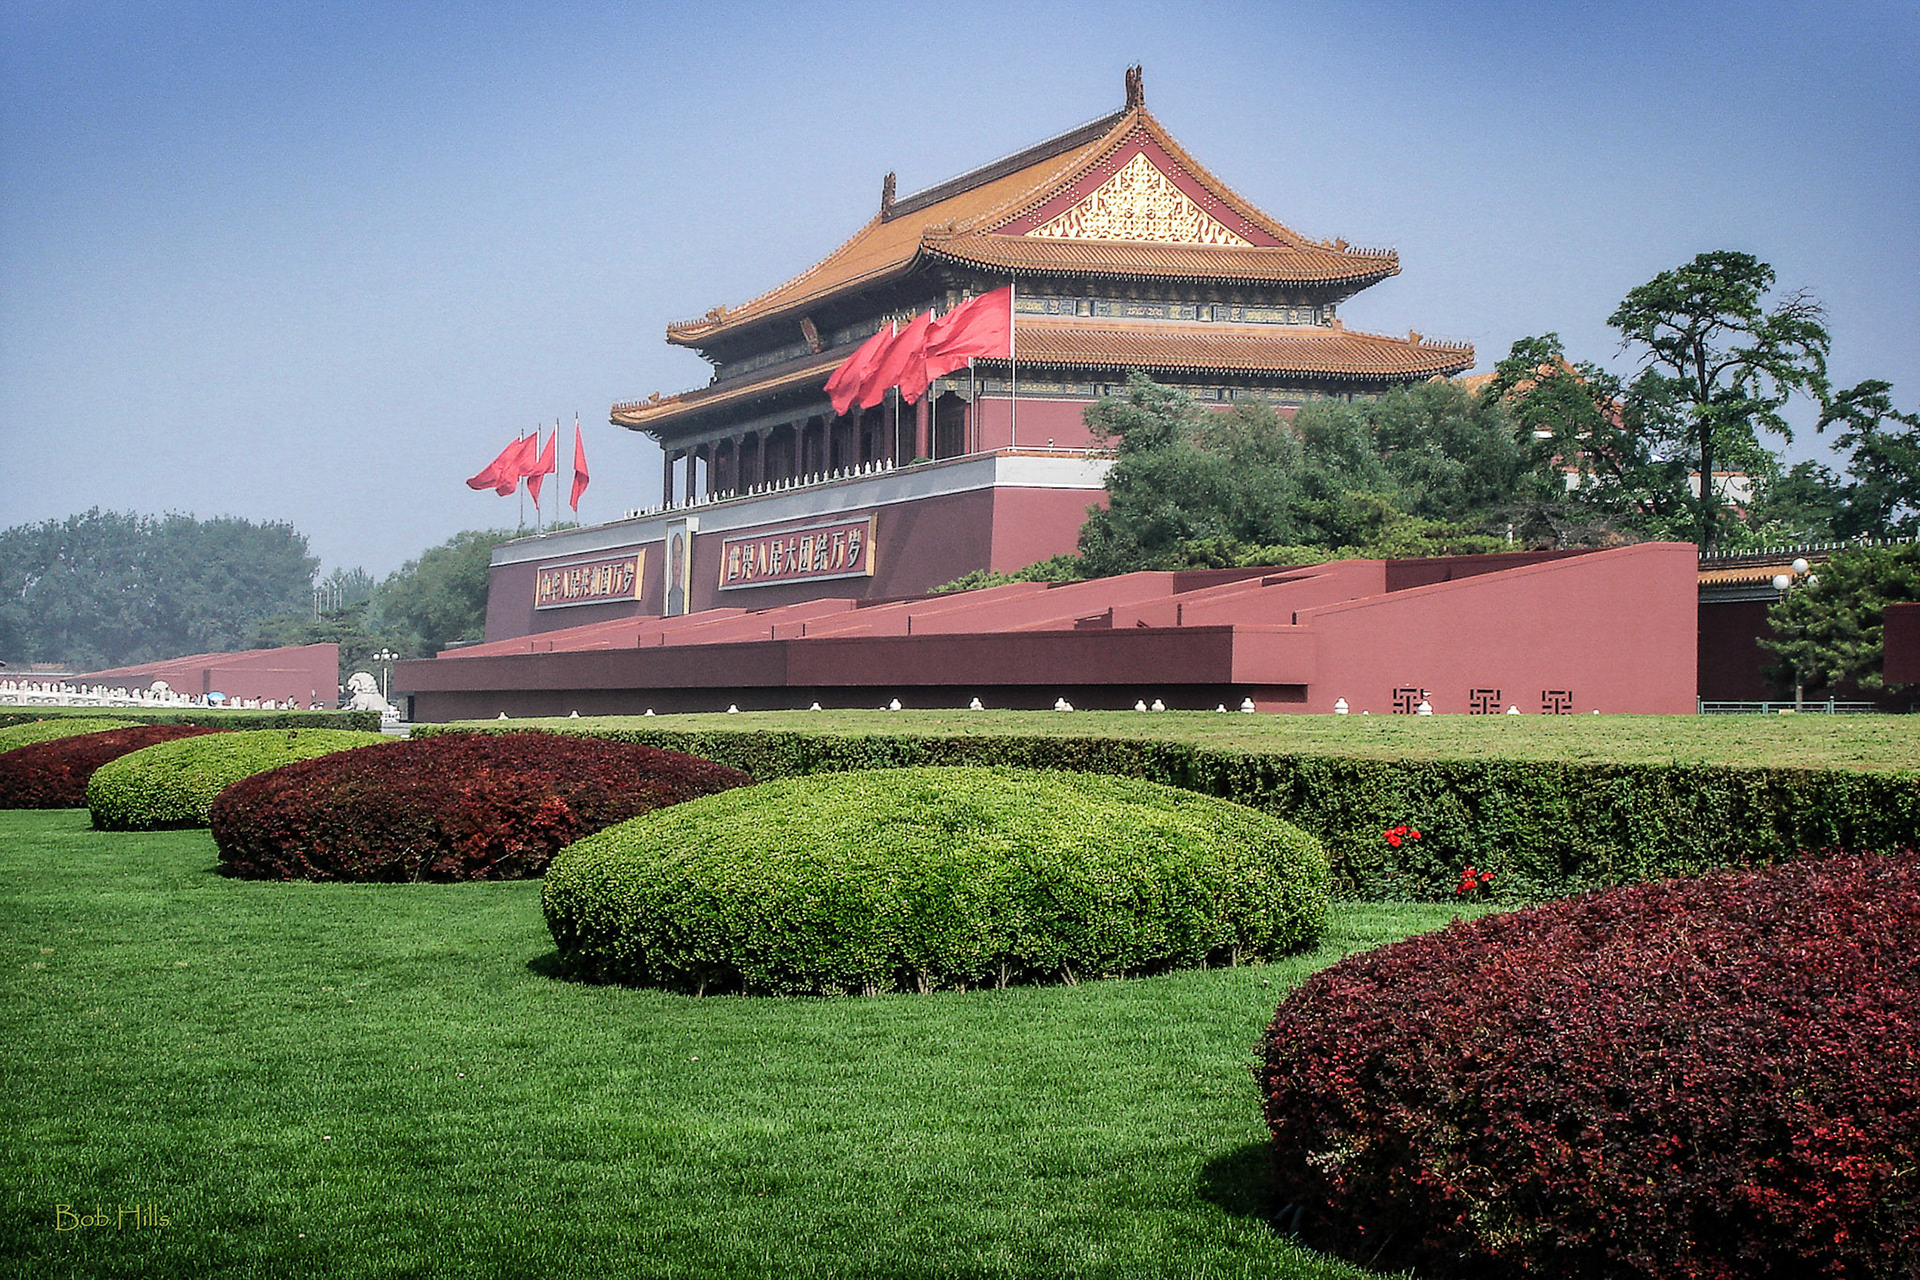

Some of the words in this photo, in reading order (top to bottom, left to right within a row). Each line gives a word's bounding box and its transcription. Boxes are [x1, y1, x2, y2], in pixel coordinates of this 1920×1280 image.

[727, 527, 863, 581] 世界人民大团结万岁
